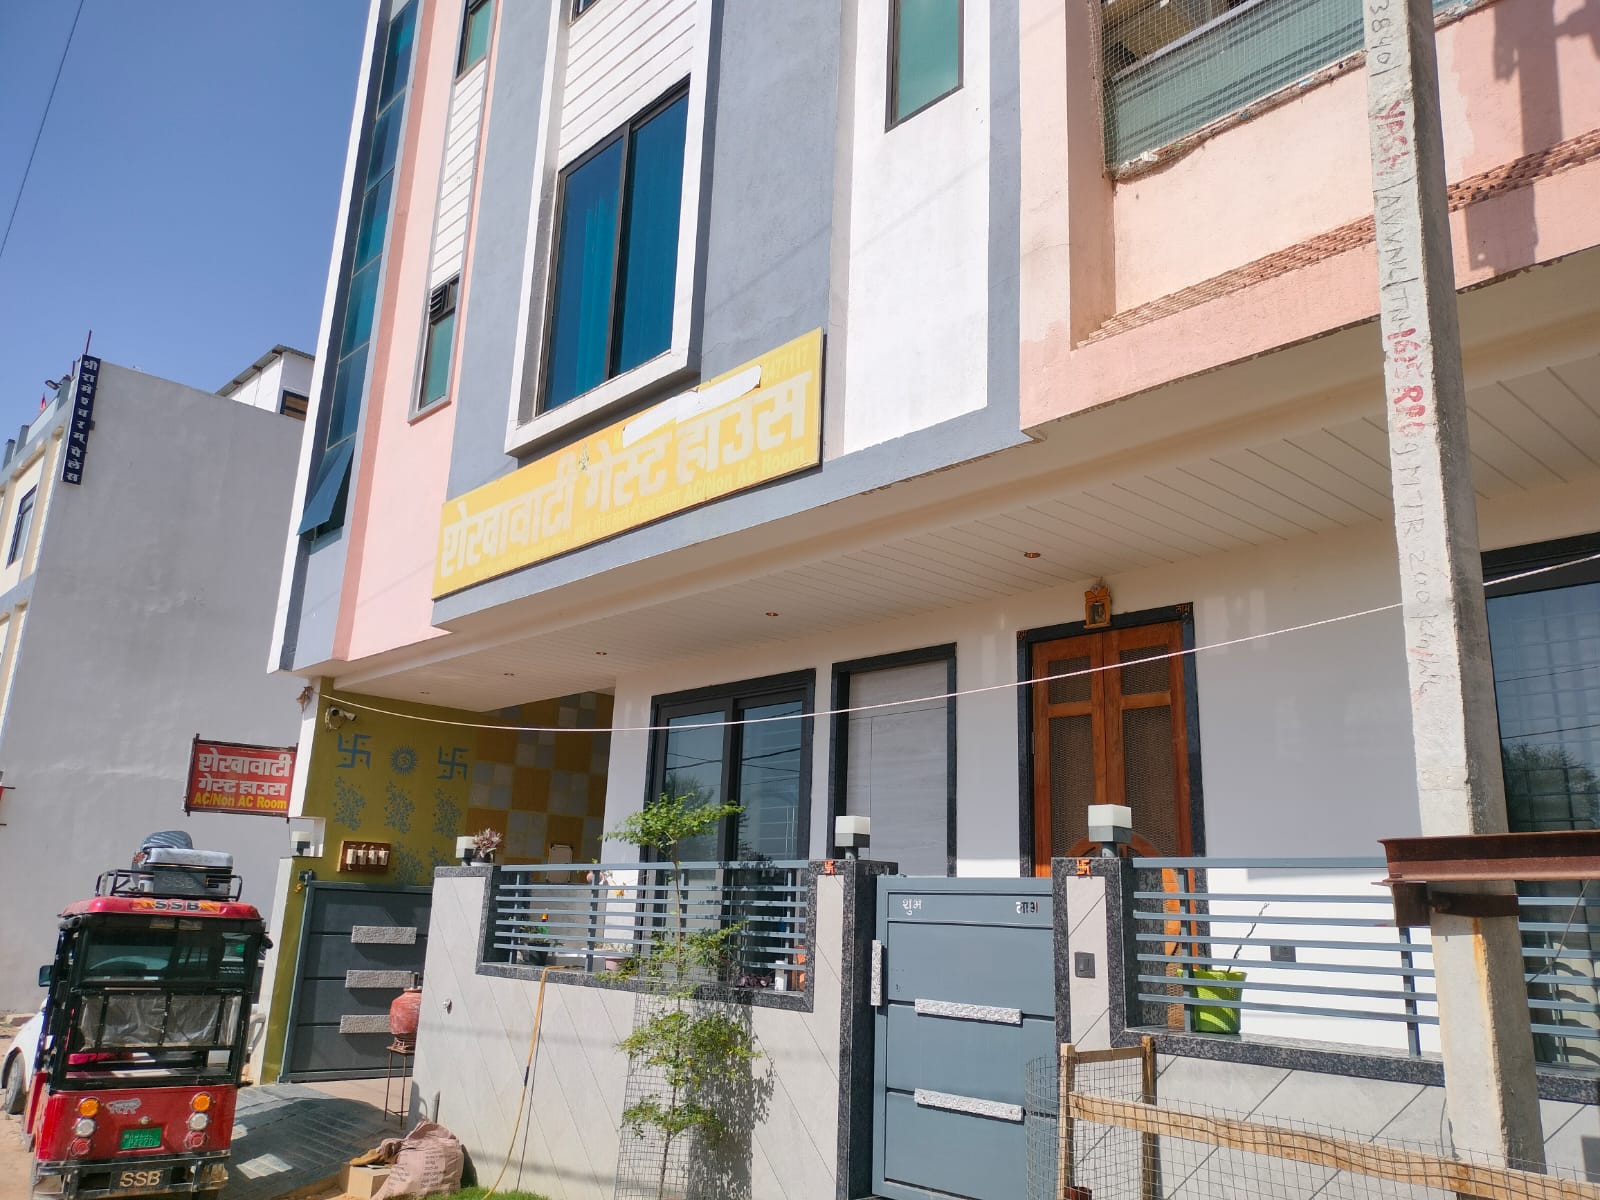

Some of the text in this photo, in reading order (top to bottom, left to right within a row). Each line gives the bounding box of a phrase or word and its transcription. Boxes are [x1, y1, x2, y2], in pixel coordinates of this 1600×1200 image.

[440, 450, 580, 578] शेखावाटी
[584, 438, 673, 512] गेस्ट
[676, 370, 813, 485] हाउस
[199, 747, 293, 777] शेखावाटी
[198, 772, 288, 797] गेस्ट हाउस
[194, 791, 287, 809] AC/Non AC Room
[154, 900, 201, 911] SSB
[902, 898, 1039, 915] शुभ लाभ
[119, 1170, 161, 1188] SSB
